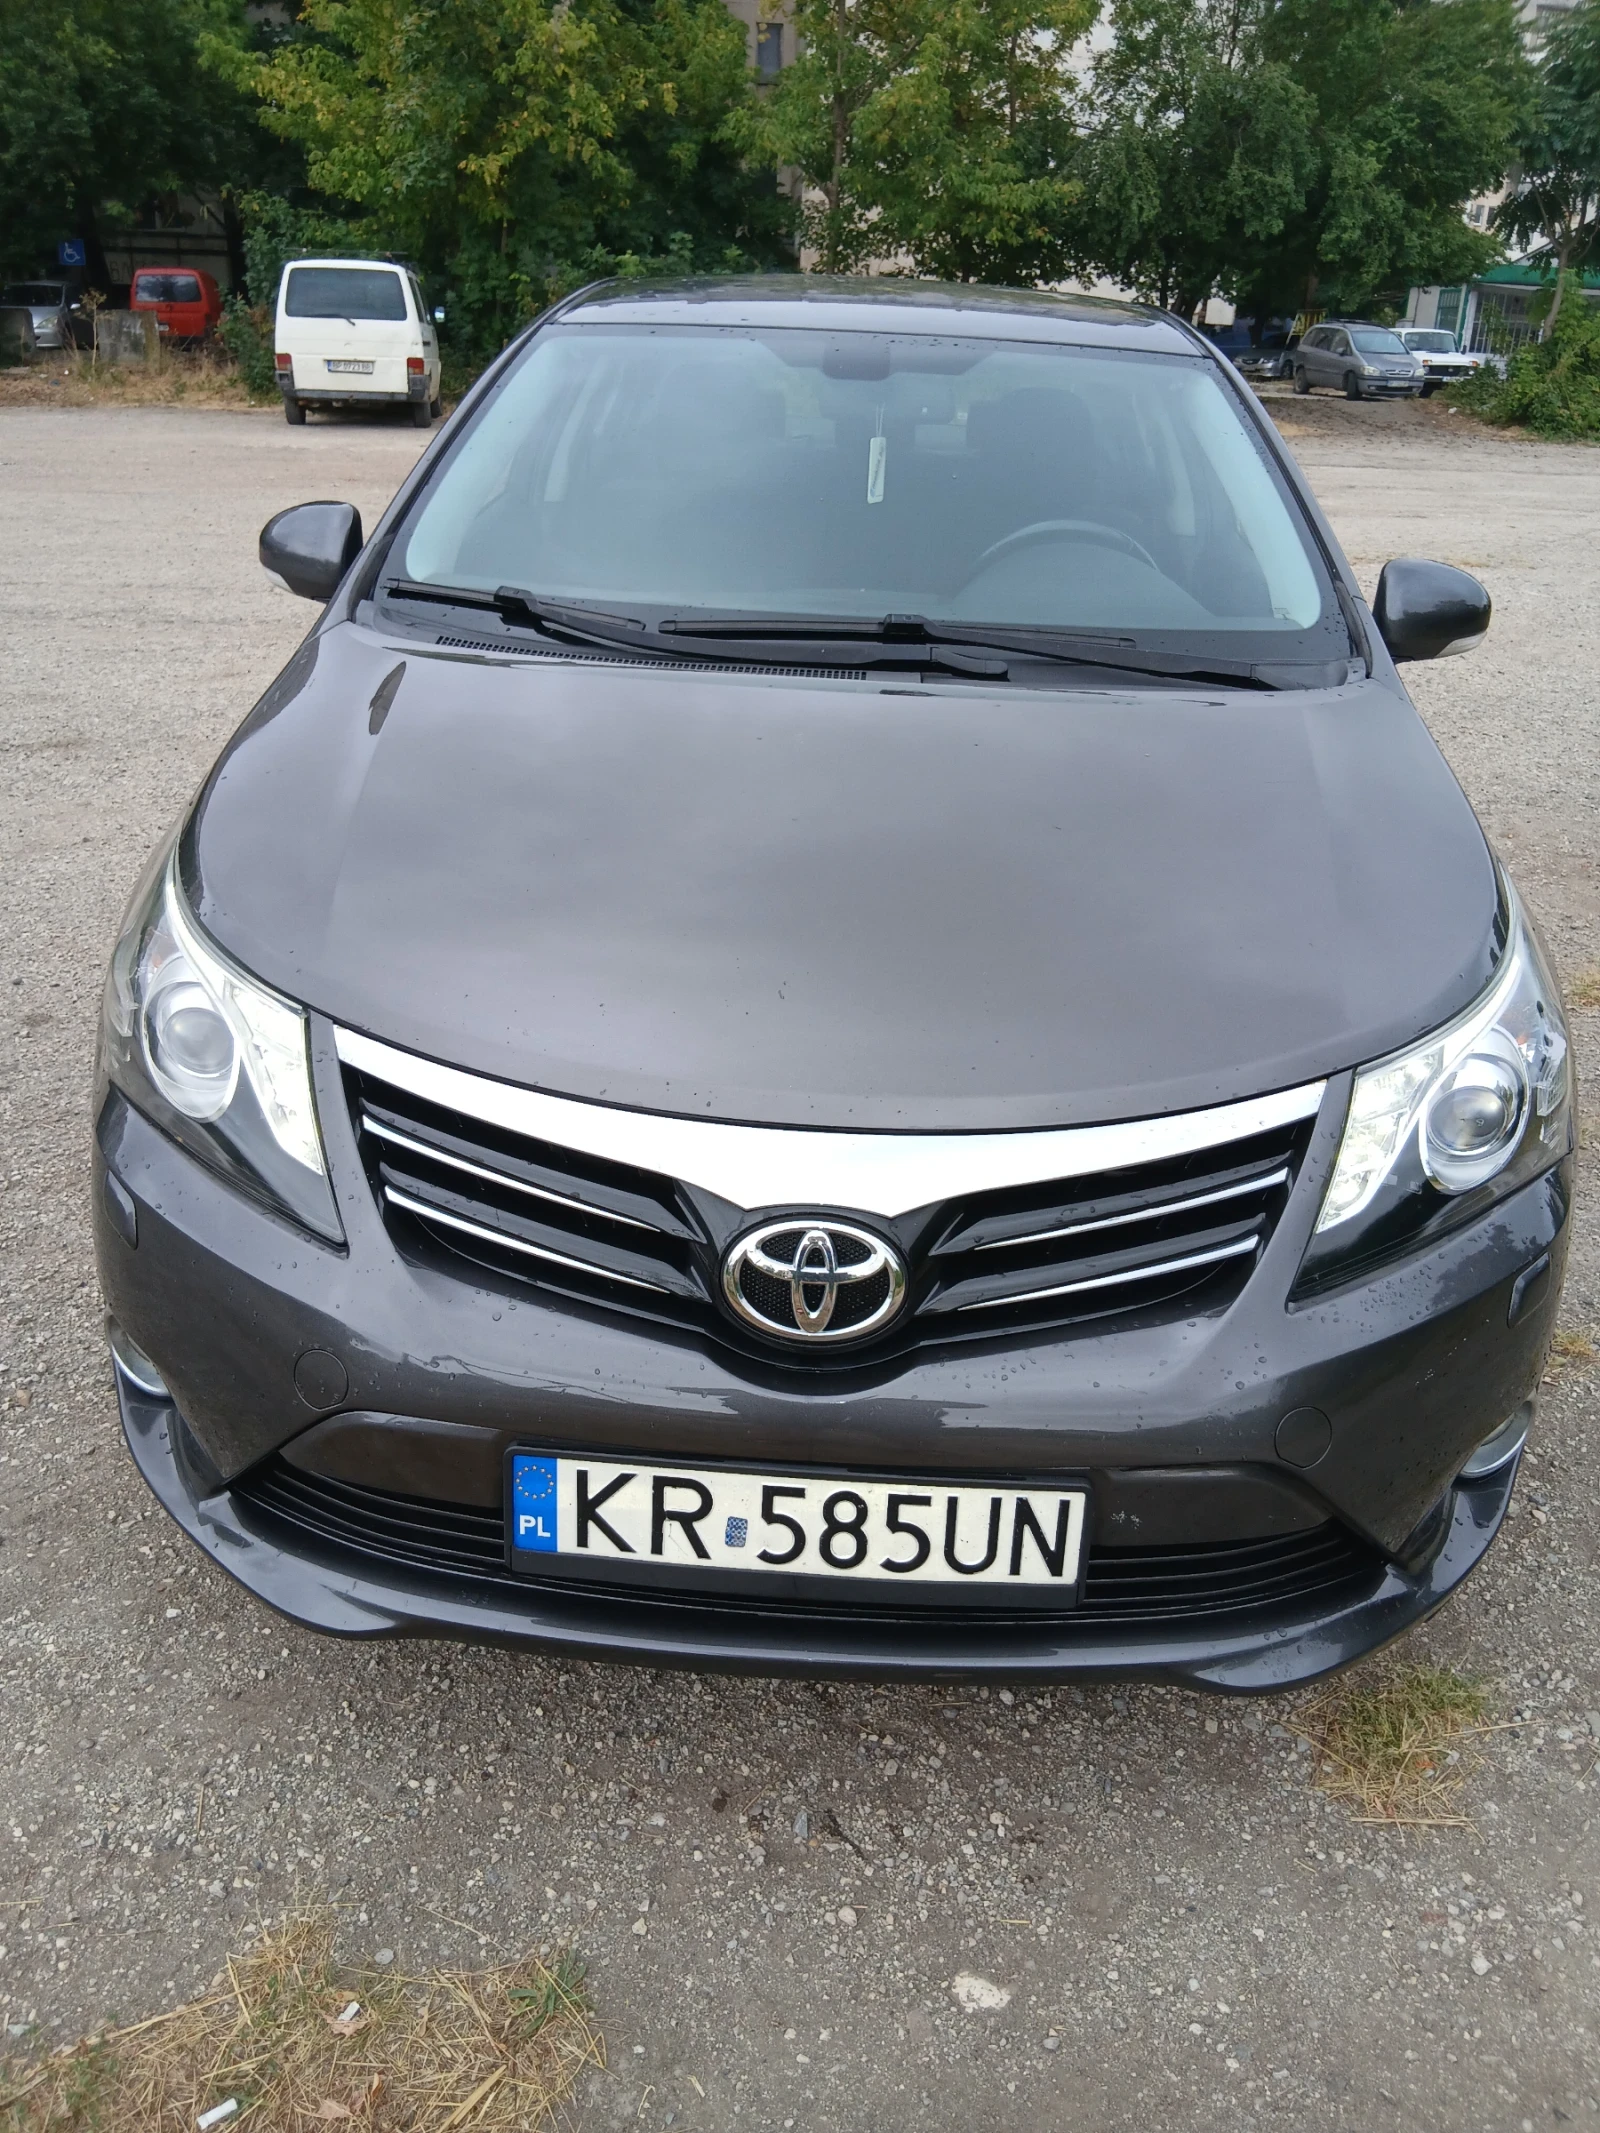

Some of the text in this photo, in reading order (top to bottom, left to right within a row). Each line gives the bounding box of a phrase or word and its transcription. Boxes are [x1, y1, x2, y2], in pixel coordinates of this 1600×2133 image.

[519, 1514, 551, 1538] PL
[576, 1469, 1071, 1577] KR 585UN
